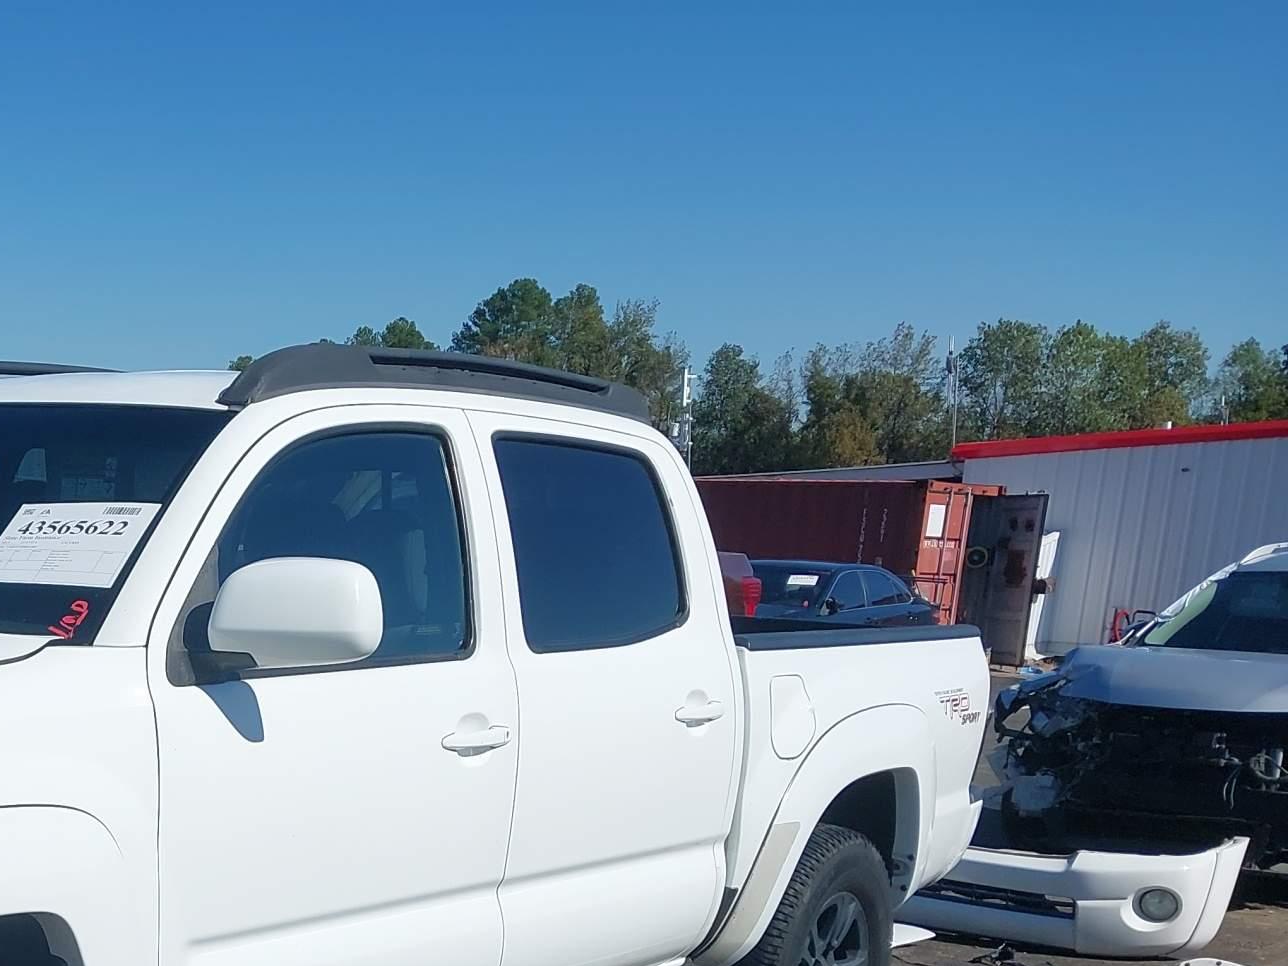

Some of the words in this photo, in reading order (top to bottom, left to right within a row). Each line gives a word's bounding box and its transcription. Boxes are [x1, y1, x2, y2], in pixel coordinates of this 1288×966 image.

[18, 520, 128, 536] 43565622
[939, 692, 970, 720] TRD
[961, 711, 981, 725] SPORT
